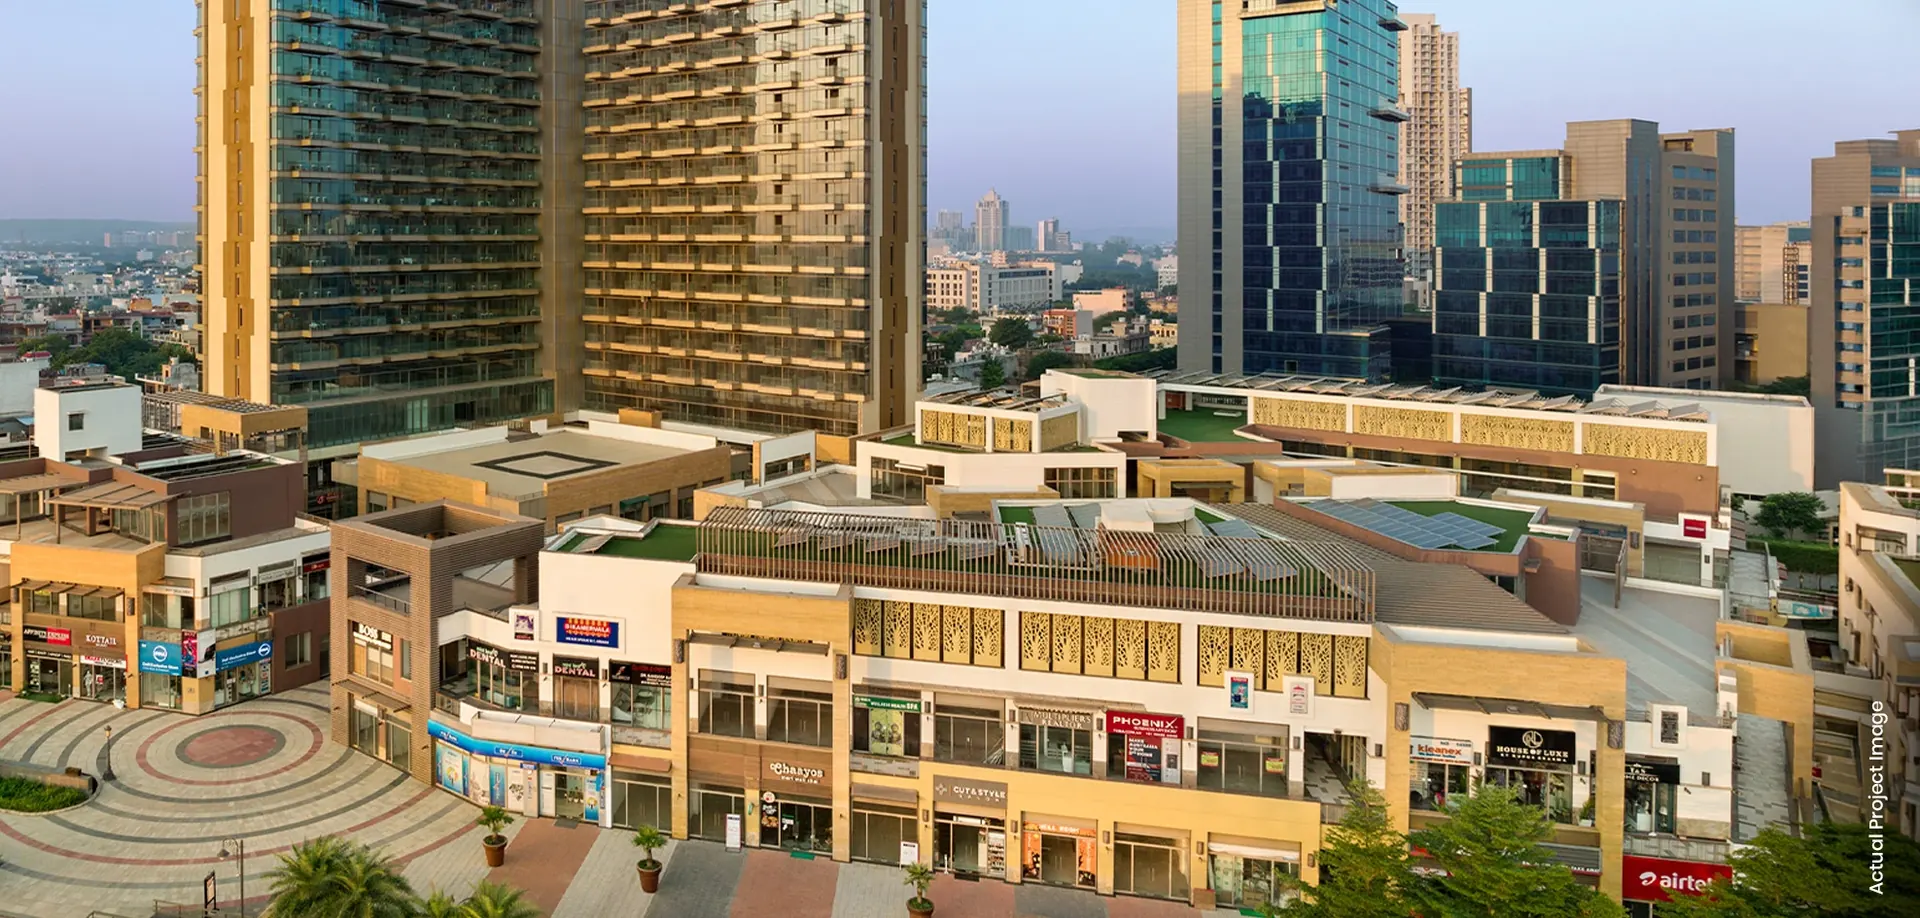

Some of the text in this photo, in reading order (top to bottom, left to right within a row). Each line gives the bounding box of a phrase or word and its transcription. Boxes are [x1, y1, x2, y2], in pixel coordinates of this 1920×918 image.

[470, 649, 506, 668] DENTAL
[555, 666, 596, 677] DENTAL
[1113, 716, 1178, 729] PHOENIX
[1417, 743, 1462, 756] kleanex
[1496, 745, 1529, 755] HOUSE
[1543, 750, 1569, 758] LUXE
[770, 762, 824, 779] Chaayos
